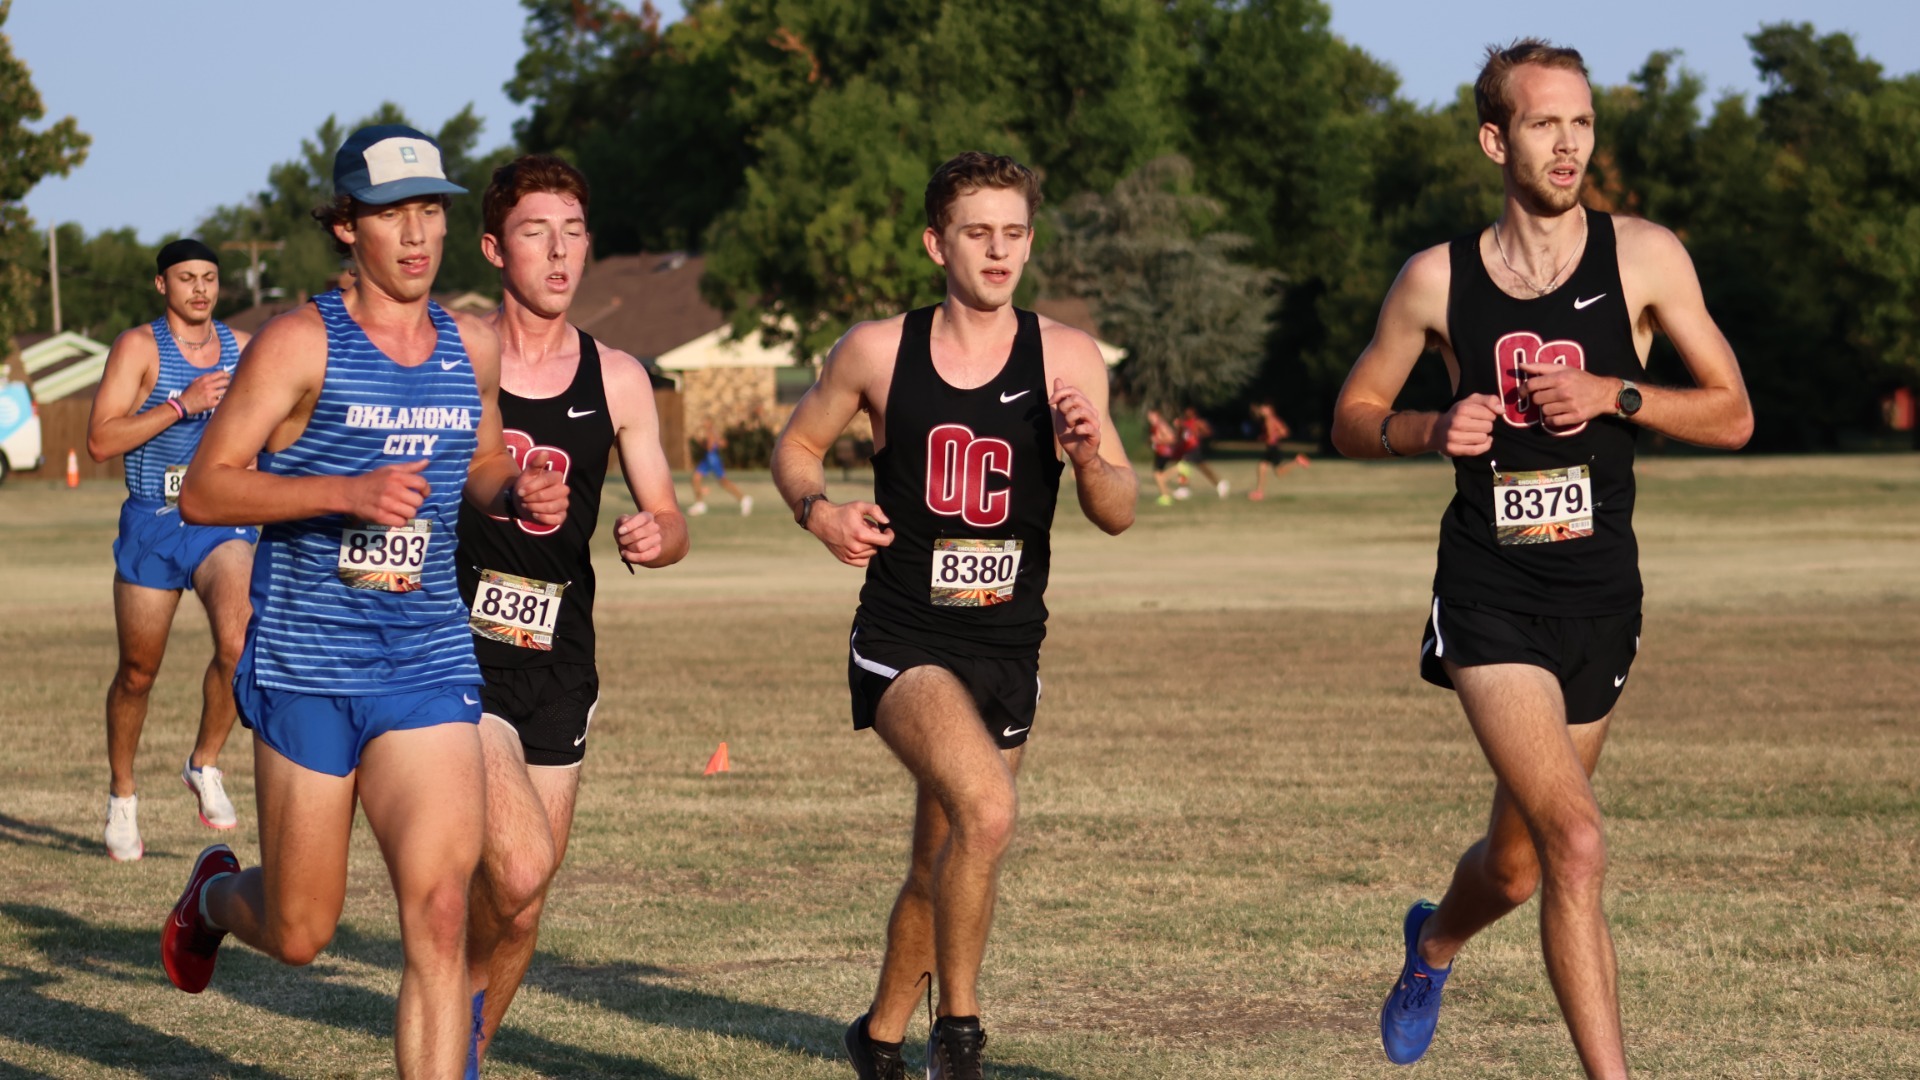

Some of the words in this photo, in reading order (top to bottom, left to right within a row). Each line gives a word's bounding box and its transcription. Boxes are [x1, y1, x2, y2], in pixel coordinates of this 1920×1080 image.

[345, 405, 472, 430] OKLAHOMA
[383, 434, 439, 456] CITY
[926, 424, 1012, 527] OC
[1504, 483, 1583, 520] 8379
[348, 533, 425, 567] 8393
[940, 554, 1014, 584] 8380
[481, 587, 550, 627] 8381
